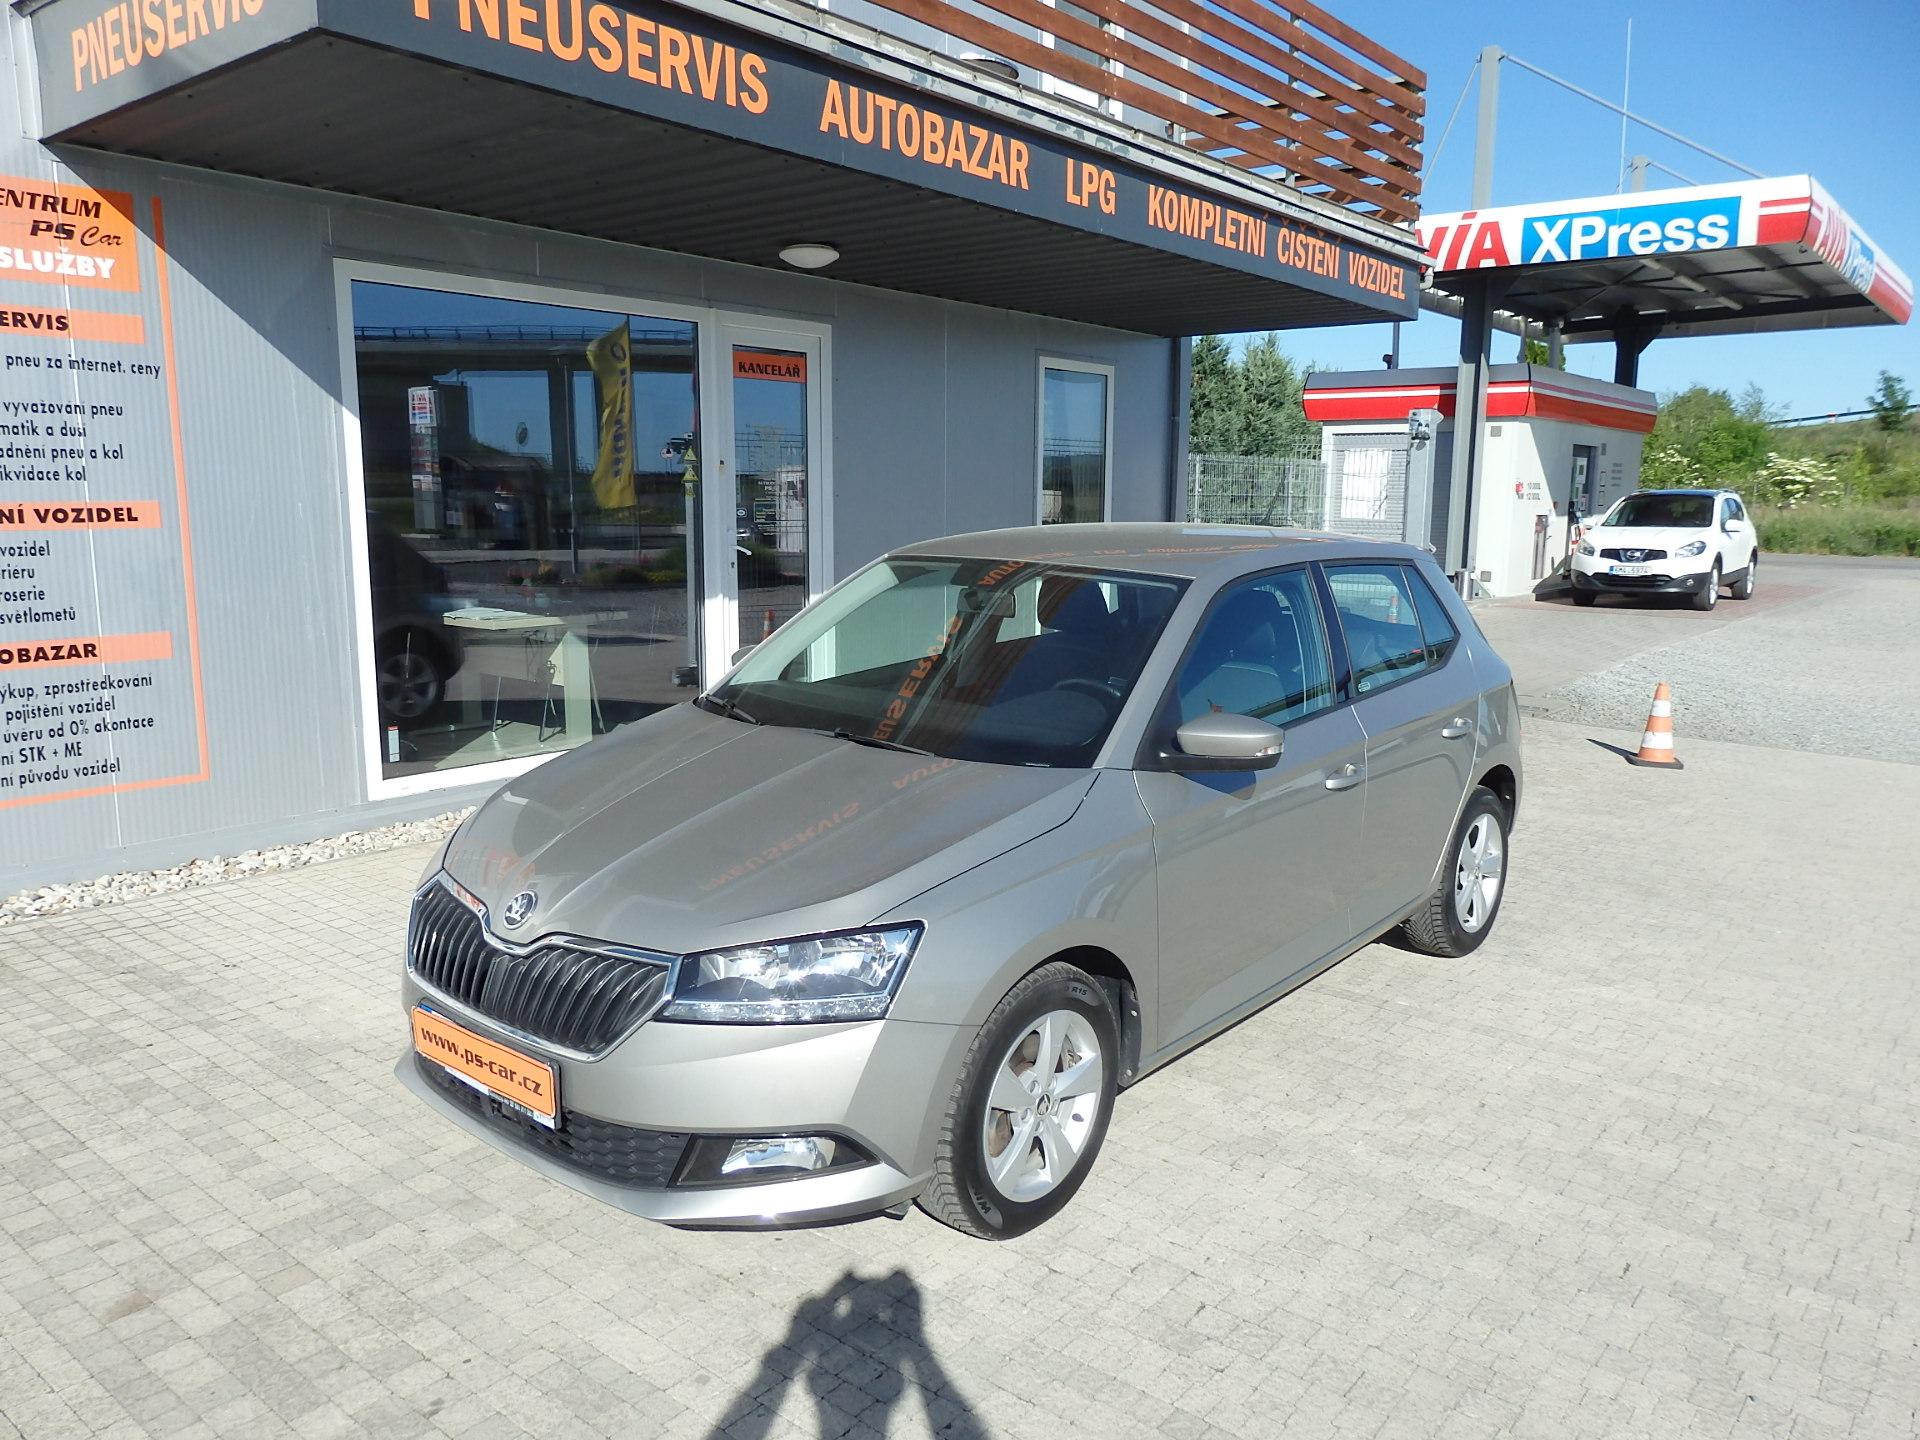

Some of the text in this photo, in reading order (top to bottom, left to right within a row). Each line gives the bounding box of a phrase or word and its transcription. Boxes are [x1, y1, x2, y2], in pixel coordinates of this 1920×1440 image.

[70, 0, 264, 93] PNEUSER
[411, 0, 769, 115] EUSERVIS
[819, 78, 1030, 191] AUTOBAZAR
[1065, 157, 1117, 216] LPG
[1348, 250, 1407, 300] VOZIDEL
[29, 219, 124, 247] PS Car
[1529, 213, 1730, 264] XPress
[0, 245, 116, 279] SLUŽBY
[0, 310, 70, 332] ERVIS
[6, 354, 41, 370] pneu
[47, 357, 63, 369] za
[131, 362, 161, 379] ceny
[738, 361, 801, 378] KANCELÁŘ
[91, 404, 123, 420] pneu
[45, 425, 55, 437] a
[51, 448, 84, 463] pneu
[89, 448, 98, 459] a
[102, 443, 124, 460] kol
[64, 464, 87, 482] kol
[0, 503, 139, 525] NÍ VOZIDEL
[0, 539, 51, 557] vozidel
[0, 563, 35, 580] riéru
[0, 643, 98, 665] OBAZAR
[68, 695, 116, 714] vozidel
[48, 721, 65, 739] od
[69, 719, 90, 736] 0%
[94, 716, 155, 734] akontace
[19, 745, 47, 764] STK
[52, 748, 59, 757] +
[64, 741, 83, 758] ME
[73, 756, 121, 778] vozidel
[421, 1027, 543, 1097] www.ps-car.cz
